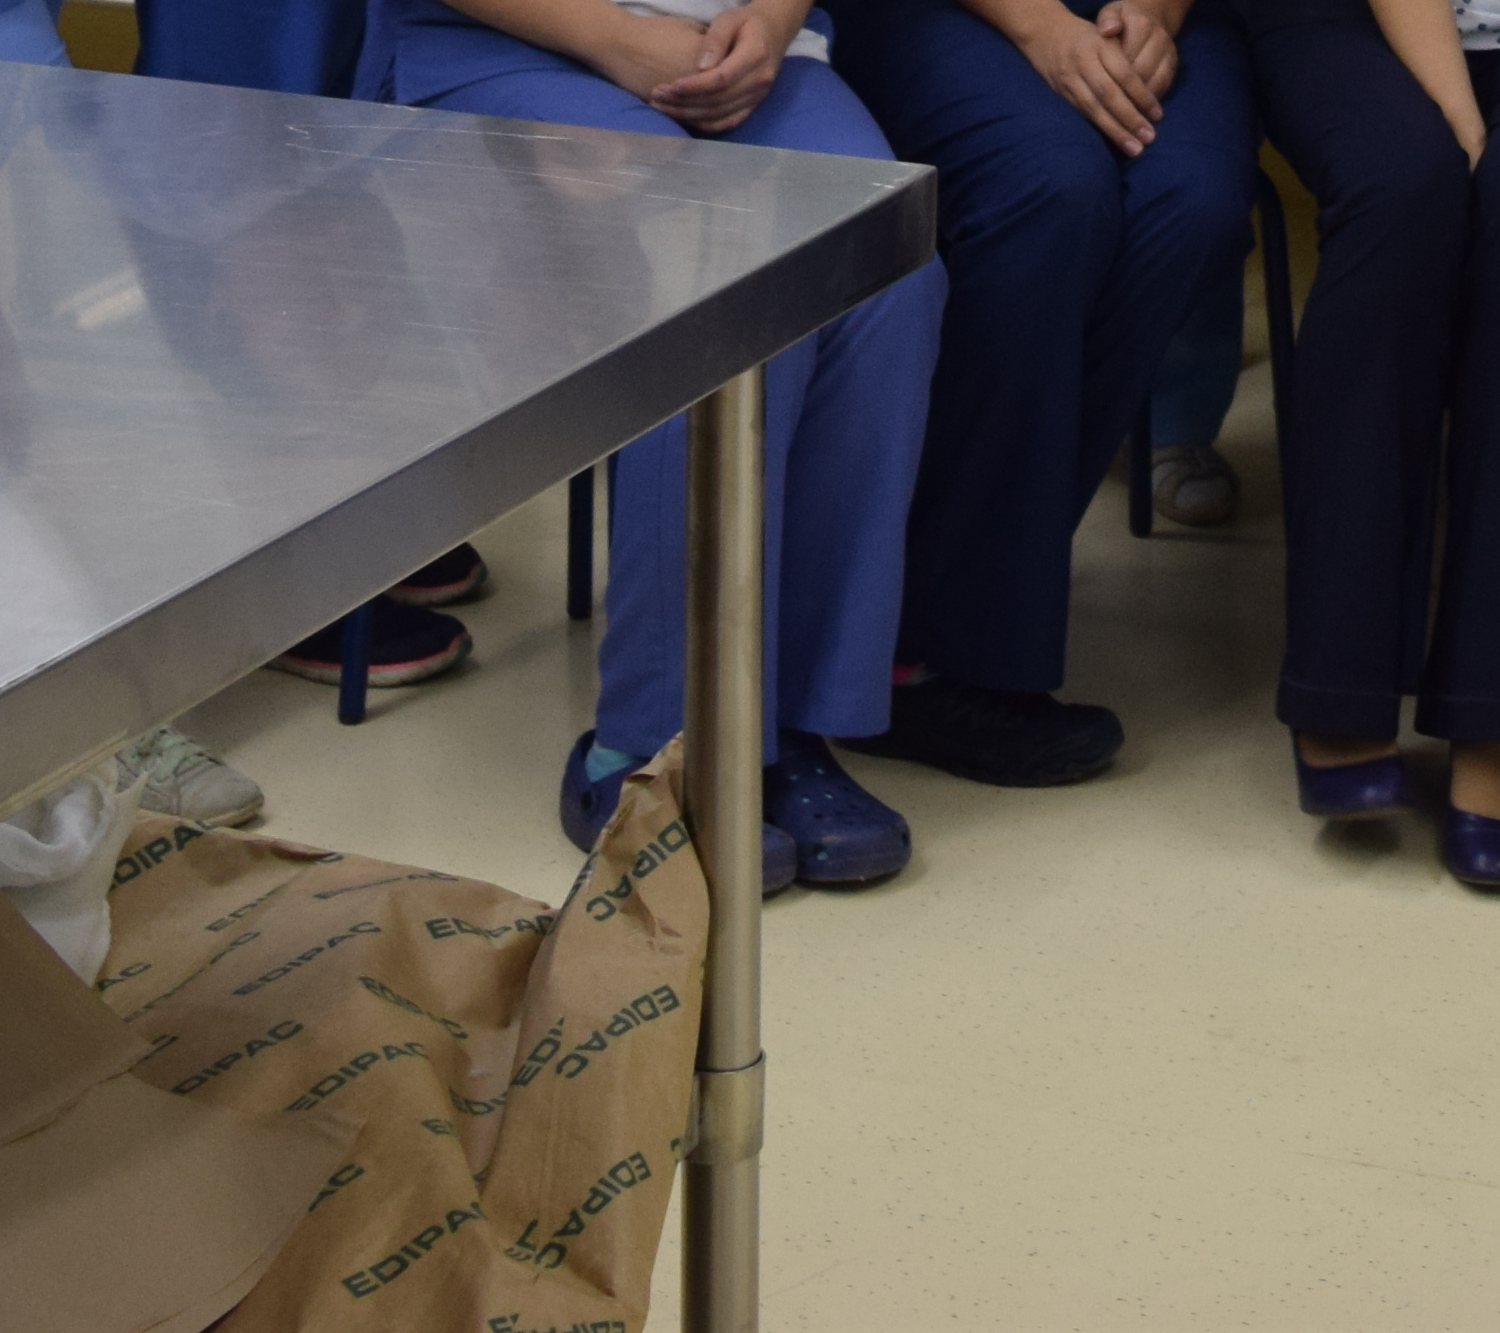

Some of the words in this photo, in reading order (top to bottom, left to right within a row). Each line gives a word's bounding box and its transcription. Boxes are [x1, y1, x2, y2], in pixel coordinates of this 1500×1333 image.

[109, 819, 221, 892] DIPA
[586, 818, 691, 923] DIPAC
[171, 1018, 303, 1096] DIPAC
[555, 984, 681, 1080] EDIPAC
[535, 1150, 653, 1270] EDIPAC
